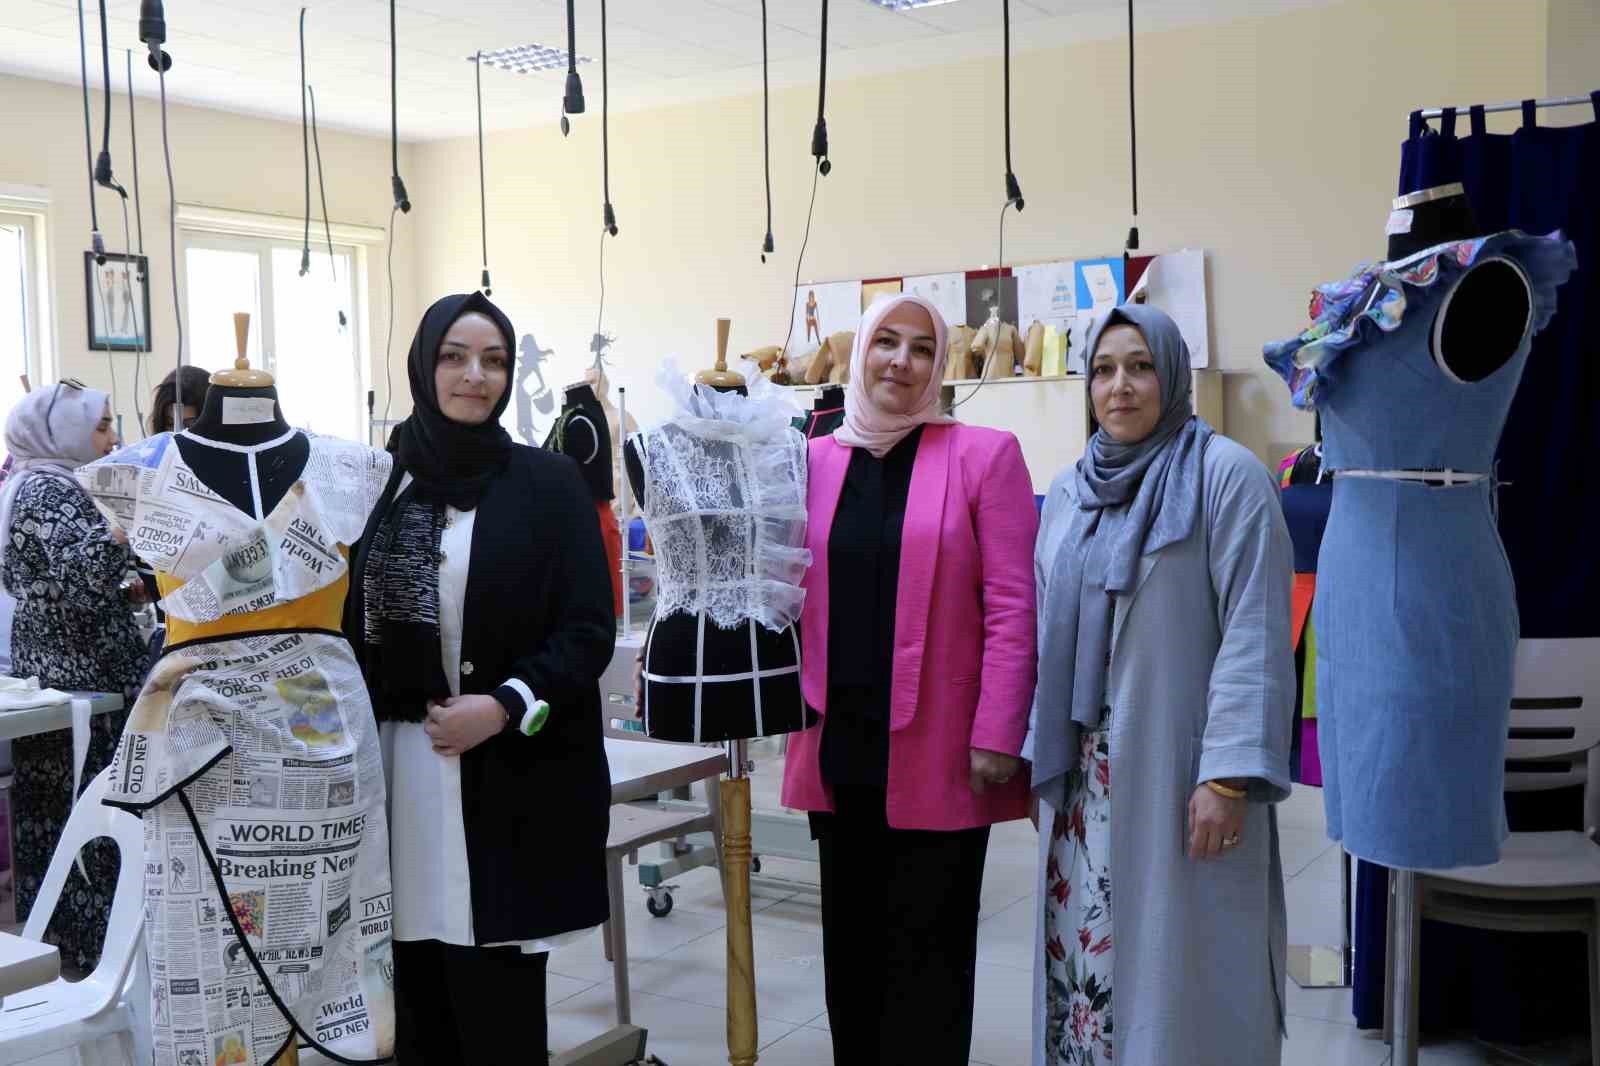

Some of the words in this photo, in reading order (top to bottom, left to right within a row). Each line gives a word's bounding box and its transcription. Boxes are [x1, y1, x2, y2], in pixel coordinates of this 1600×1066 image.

[136, 526, 184, 545] WORLD
[280, 538, 323, 574] World
[250, 671, 271, 683] OF
[130, 764, 144, 794] OLD
[230, 824, 314, 842] WORLD
[321, 814, 367, 841] TIMES
[218, 857, 317, 879] Breaking
[360, 920, 389, 937] WORLD
[321, 993, 364, 1017] World
[317, 1027, 343, 1043] OLD
